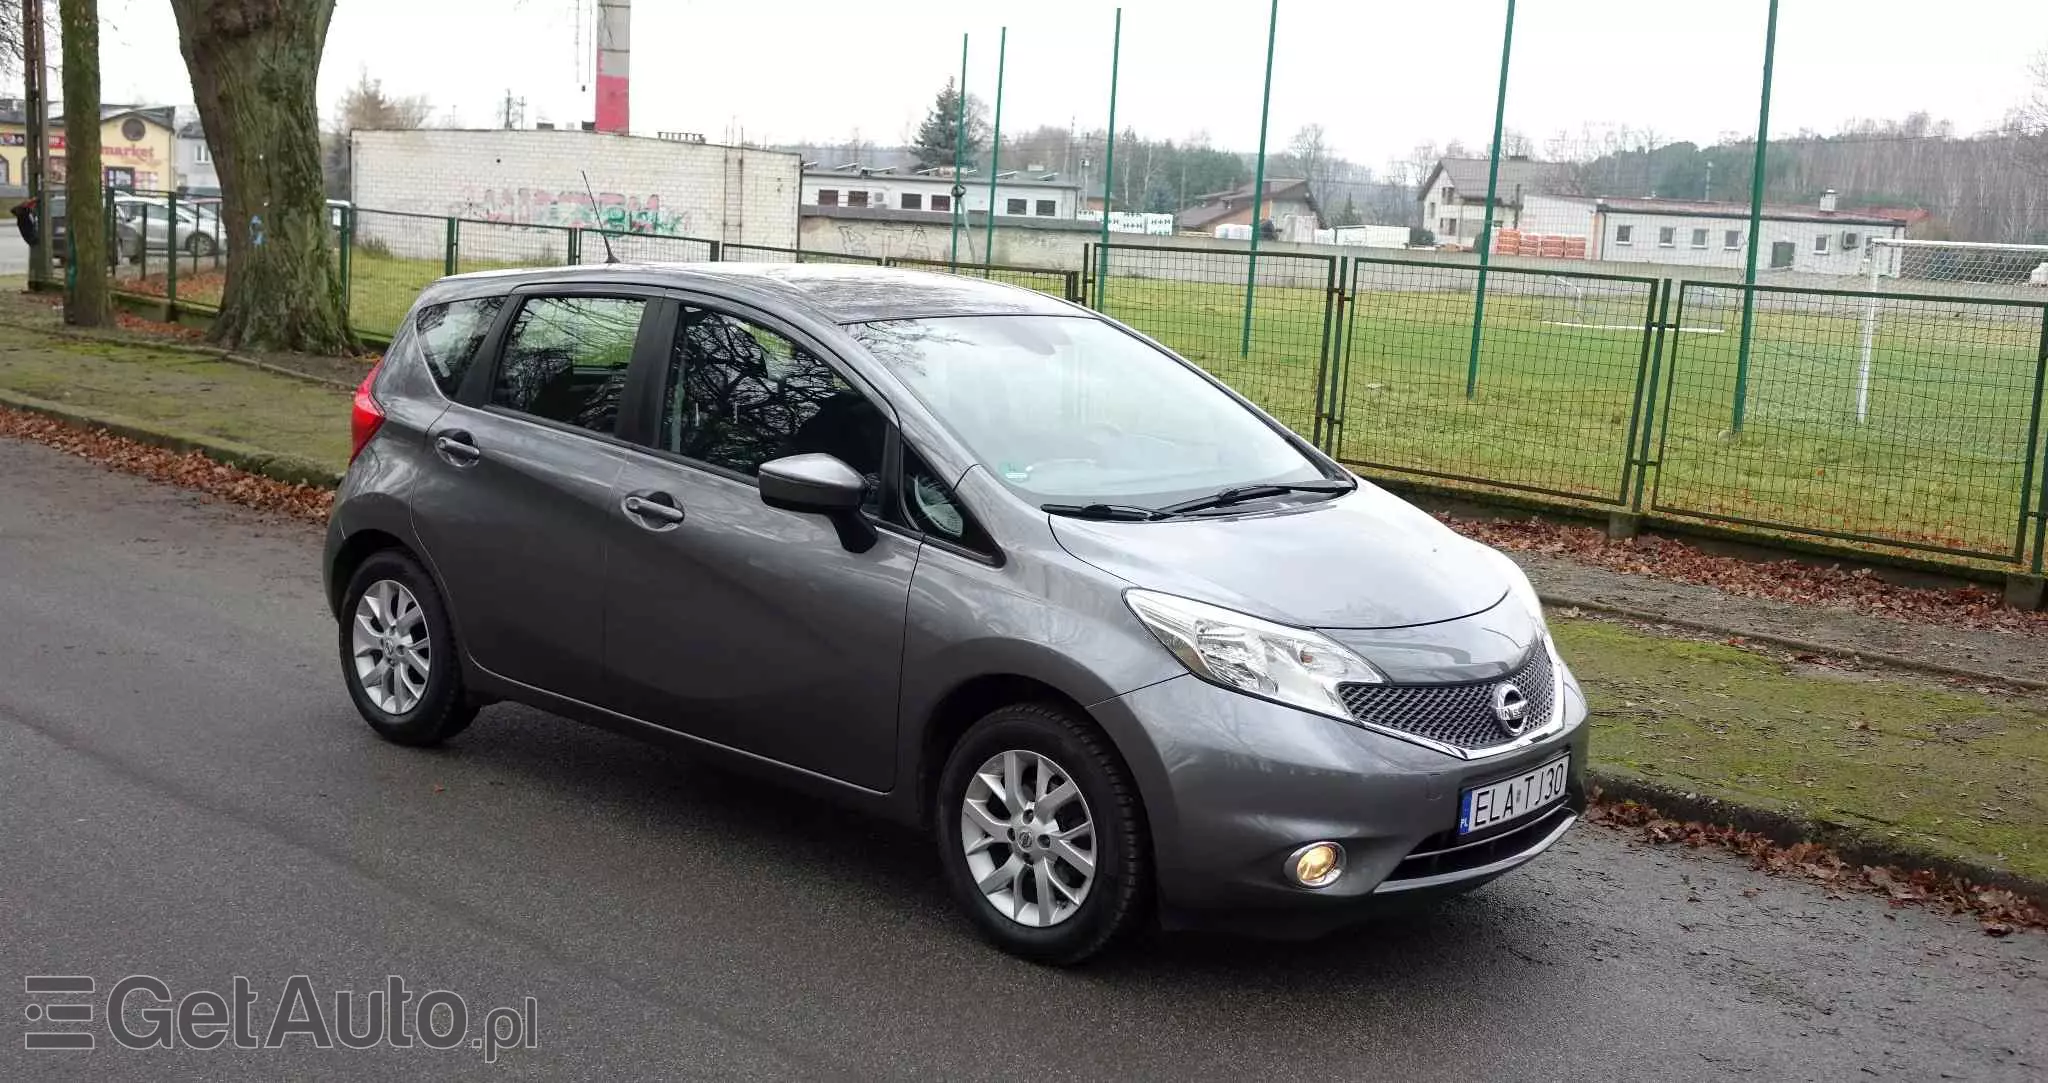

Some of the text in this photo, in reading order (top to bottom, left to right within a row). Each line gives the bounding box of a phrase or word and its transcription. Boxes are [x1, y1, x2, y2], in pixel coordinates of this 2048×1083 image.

[1475, 763, 1564, 826] ELA TJ30
[1460, 816, 1469, 829] PL
